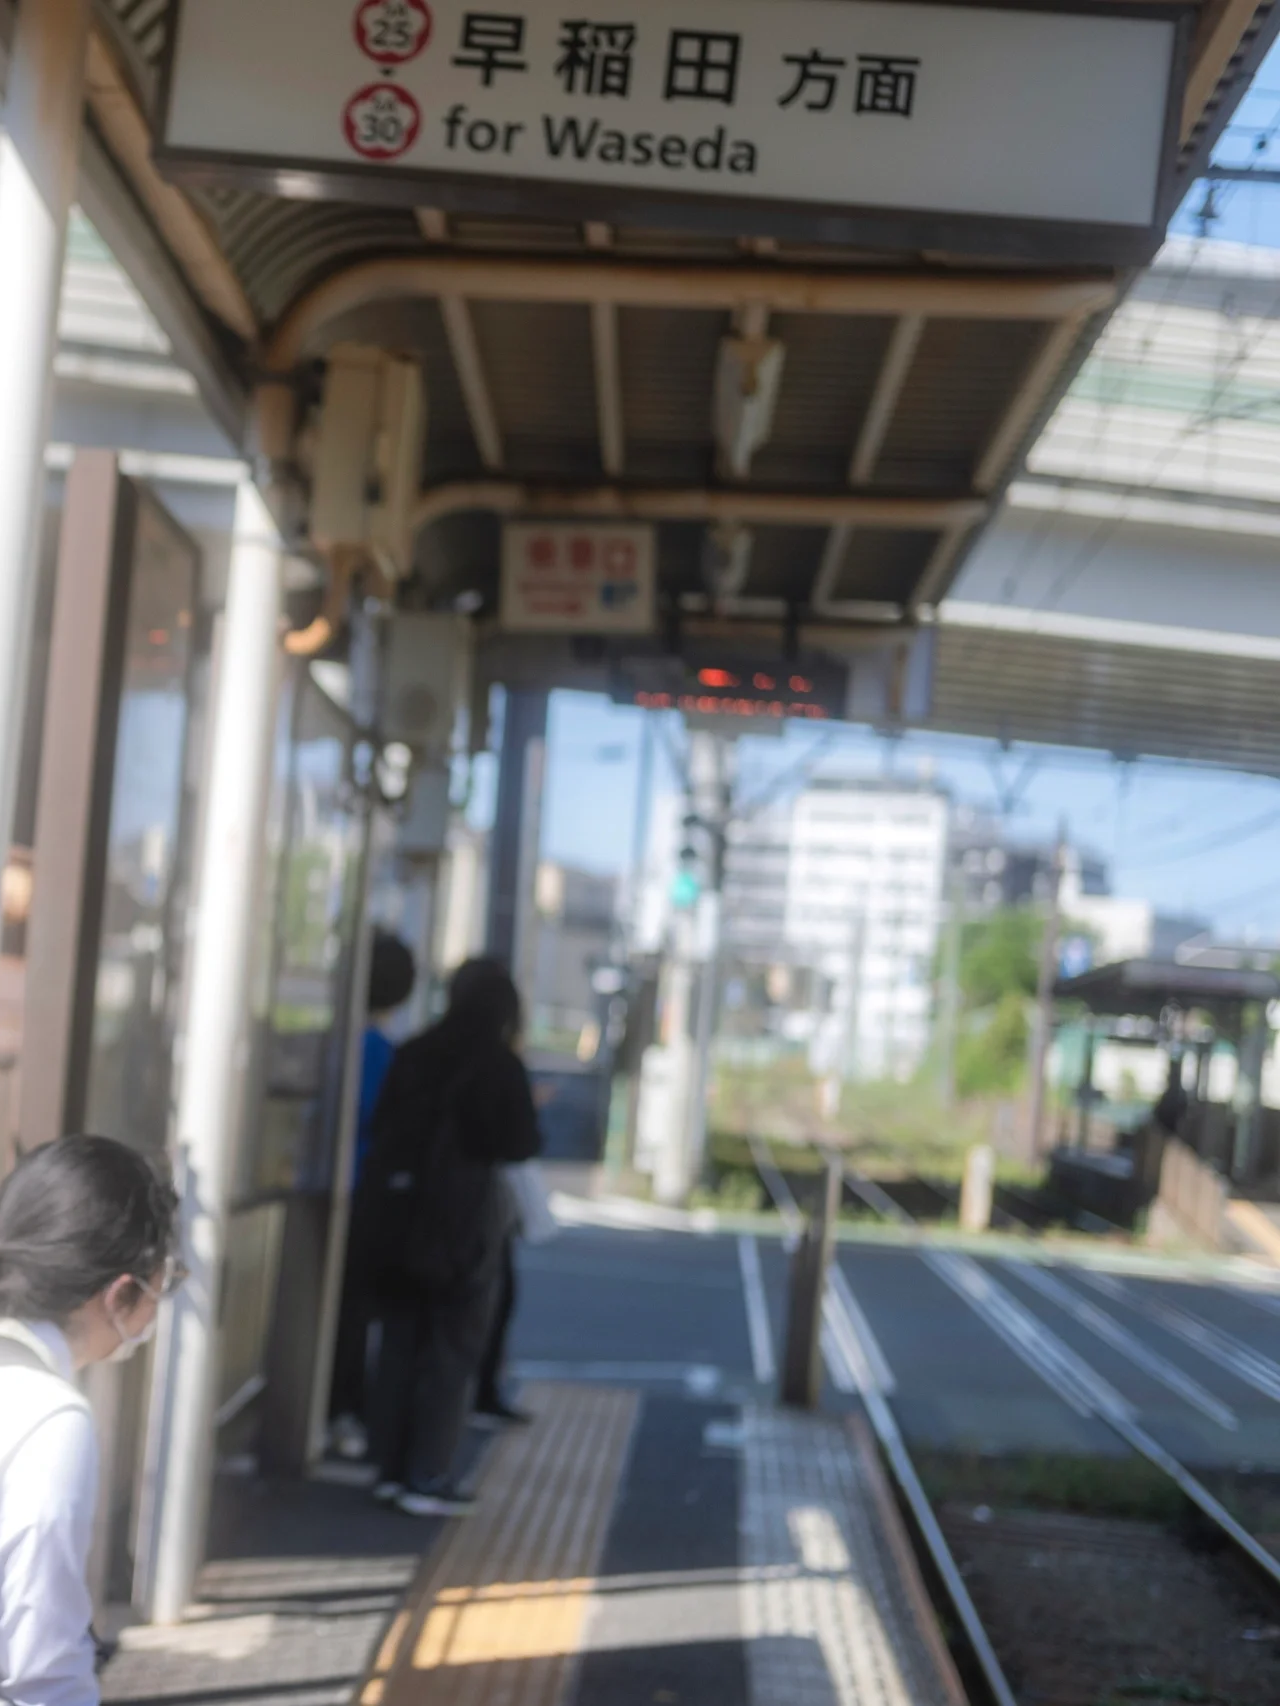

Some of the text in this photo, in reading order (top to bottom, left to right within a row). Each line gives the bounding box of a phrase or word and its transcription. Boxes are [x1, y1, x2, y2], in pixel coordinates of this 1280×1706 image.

[372, 19, 411, 48] 25
[451, 12, 922, 118] 早稲田 方面
[360, 113, 402, 144] 30
[442, 104, 759, 174] for Waseda
